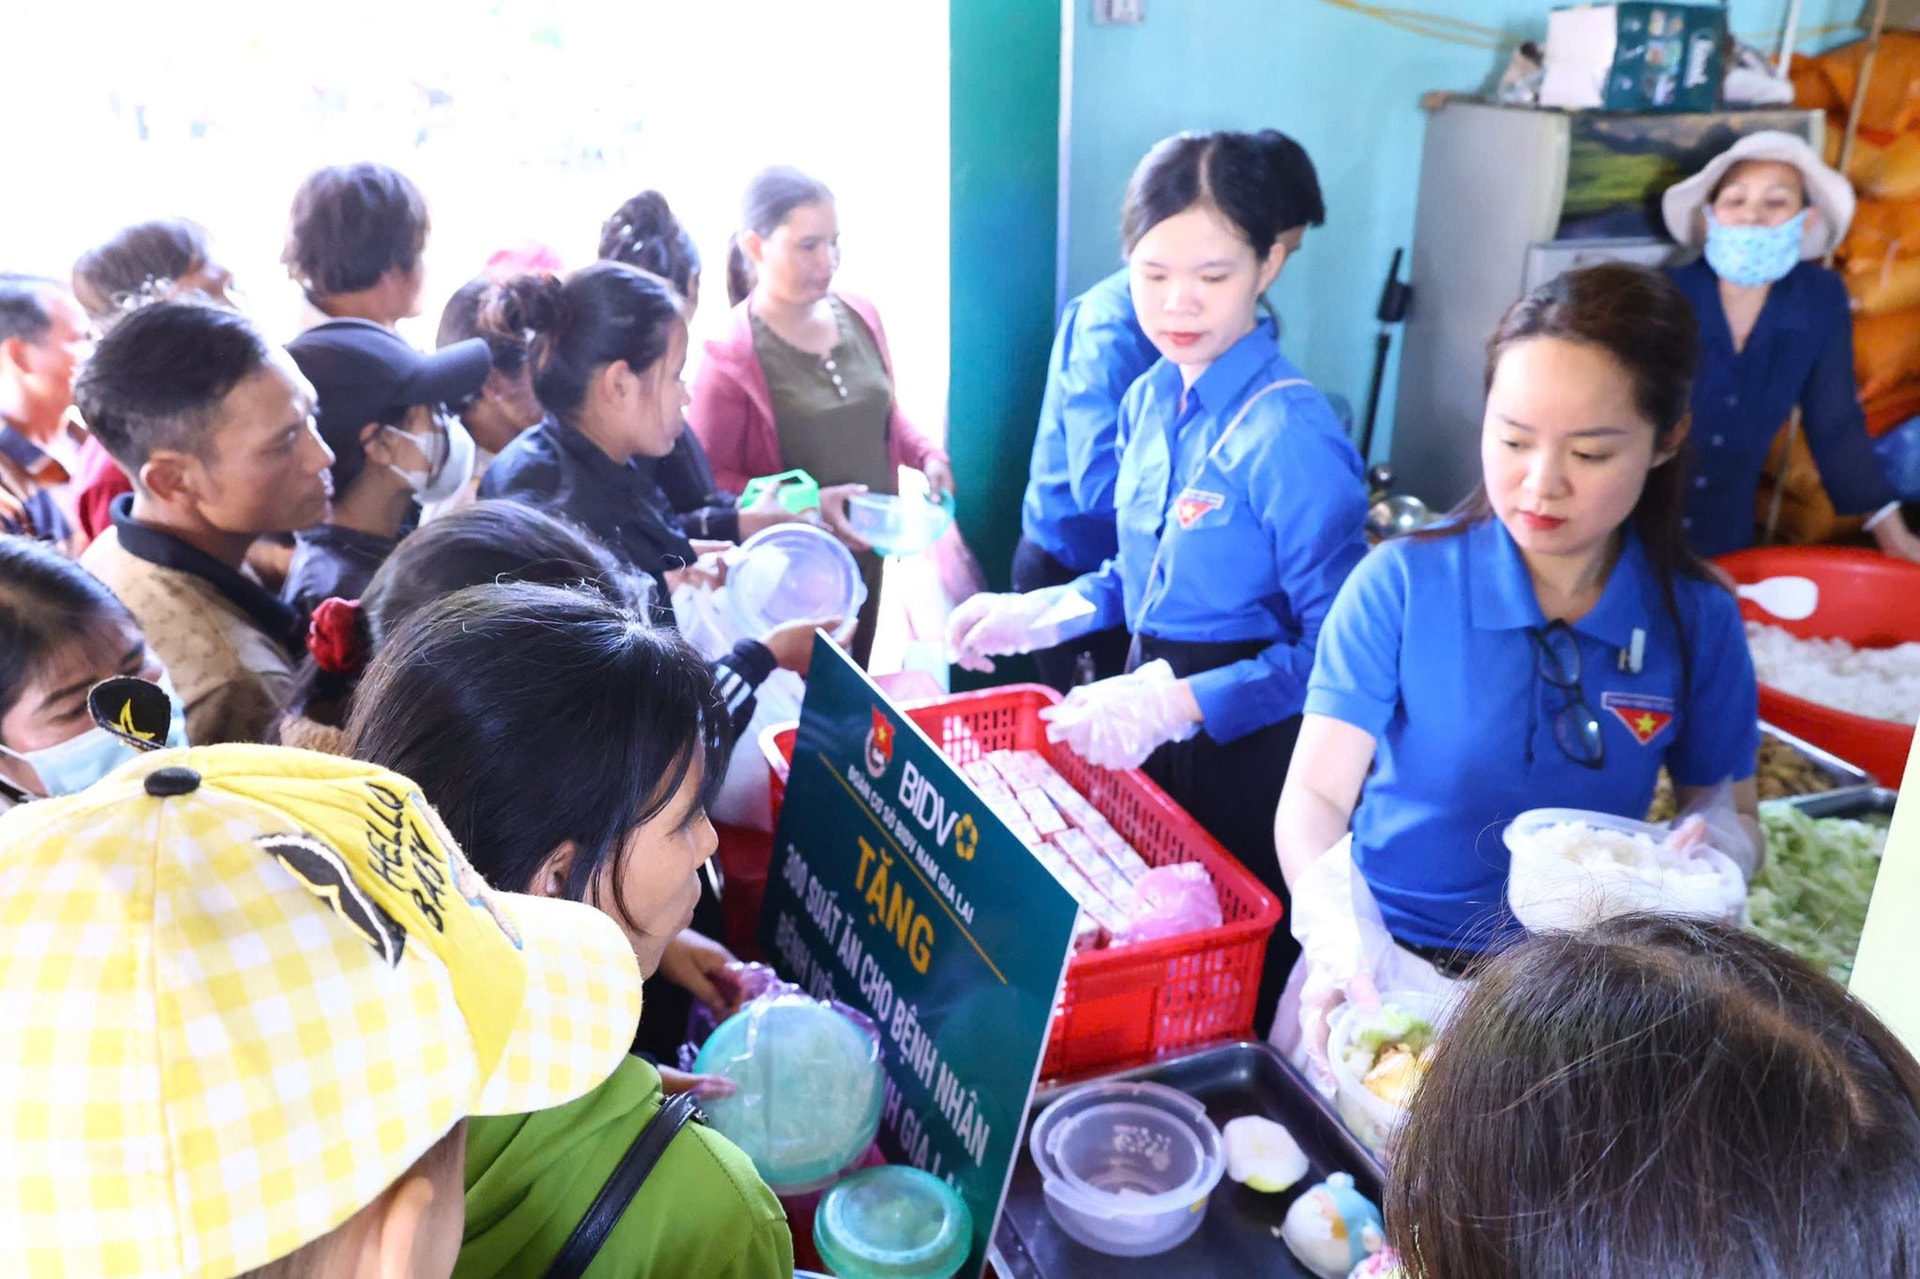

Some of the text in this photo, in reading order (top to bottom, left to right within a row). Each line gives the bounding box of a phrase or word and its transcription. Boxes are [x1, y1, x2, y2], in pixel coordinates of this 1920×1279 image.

[365, 782, 404, 892] HELLO
[898, 760, 959, 847] BIDV
[855, 835, 935, 974] TẶNG
[915, 844, 939, 881] NAM
[938, 872, 956, 904] GIA
[955, 892, 974, 925] LAI
[805, 875, 842, 945] SUẤT
[837, 913, 863, 979] ĂN
[859, 953, 893, 1022] CHO
[890, 997, 938, 1089] BỆNH
[933, 1061, 990, 1168] NHÂN
[900, 1108, 930, 1170] GIA
